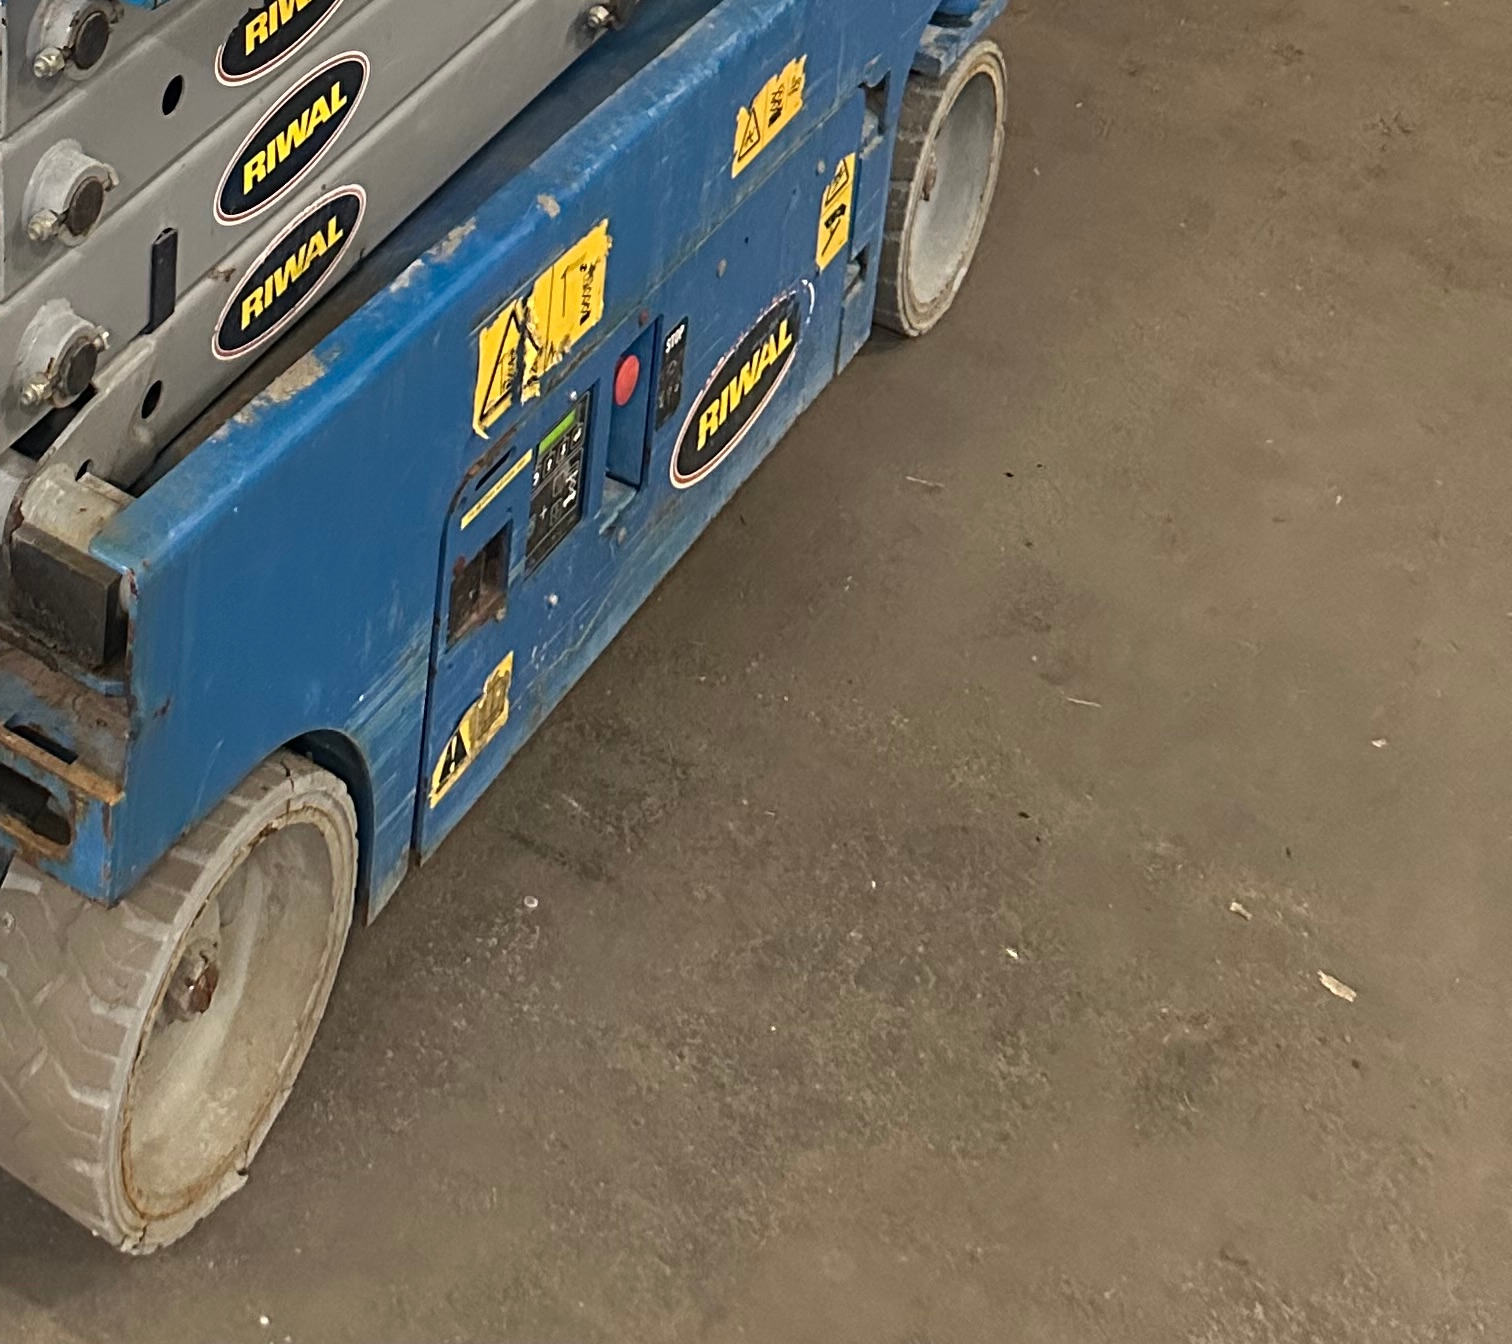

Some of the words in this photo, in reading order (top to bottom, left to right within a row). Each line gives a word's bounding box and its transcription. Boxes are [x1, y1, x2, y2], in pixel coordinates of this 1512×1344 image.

[243, 81, 347, 195] RIWAL
[240, 216, 344, 330] RIWAL
[697, 319, 793, 451] RIWAL
